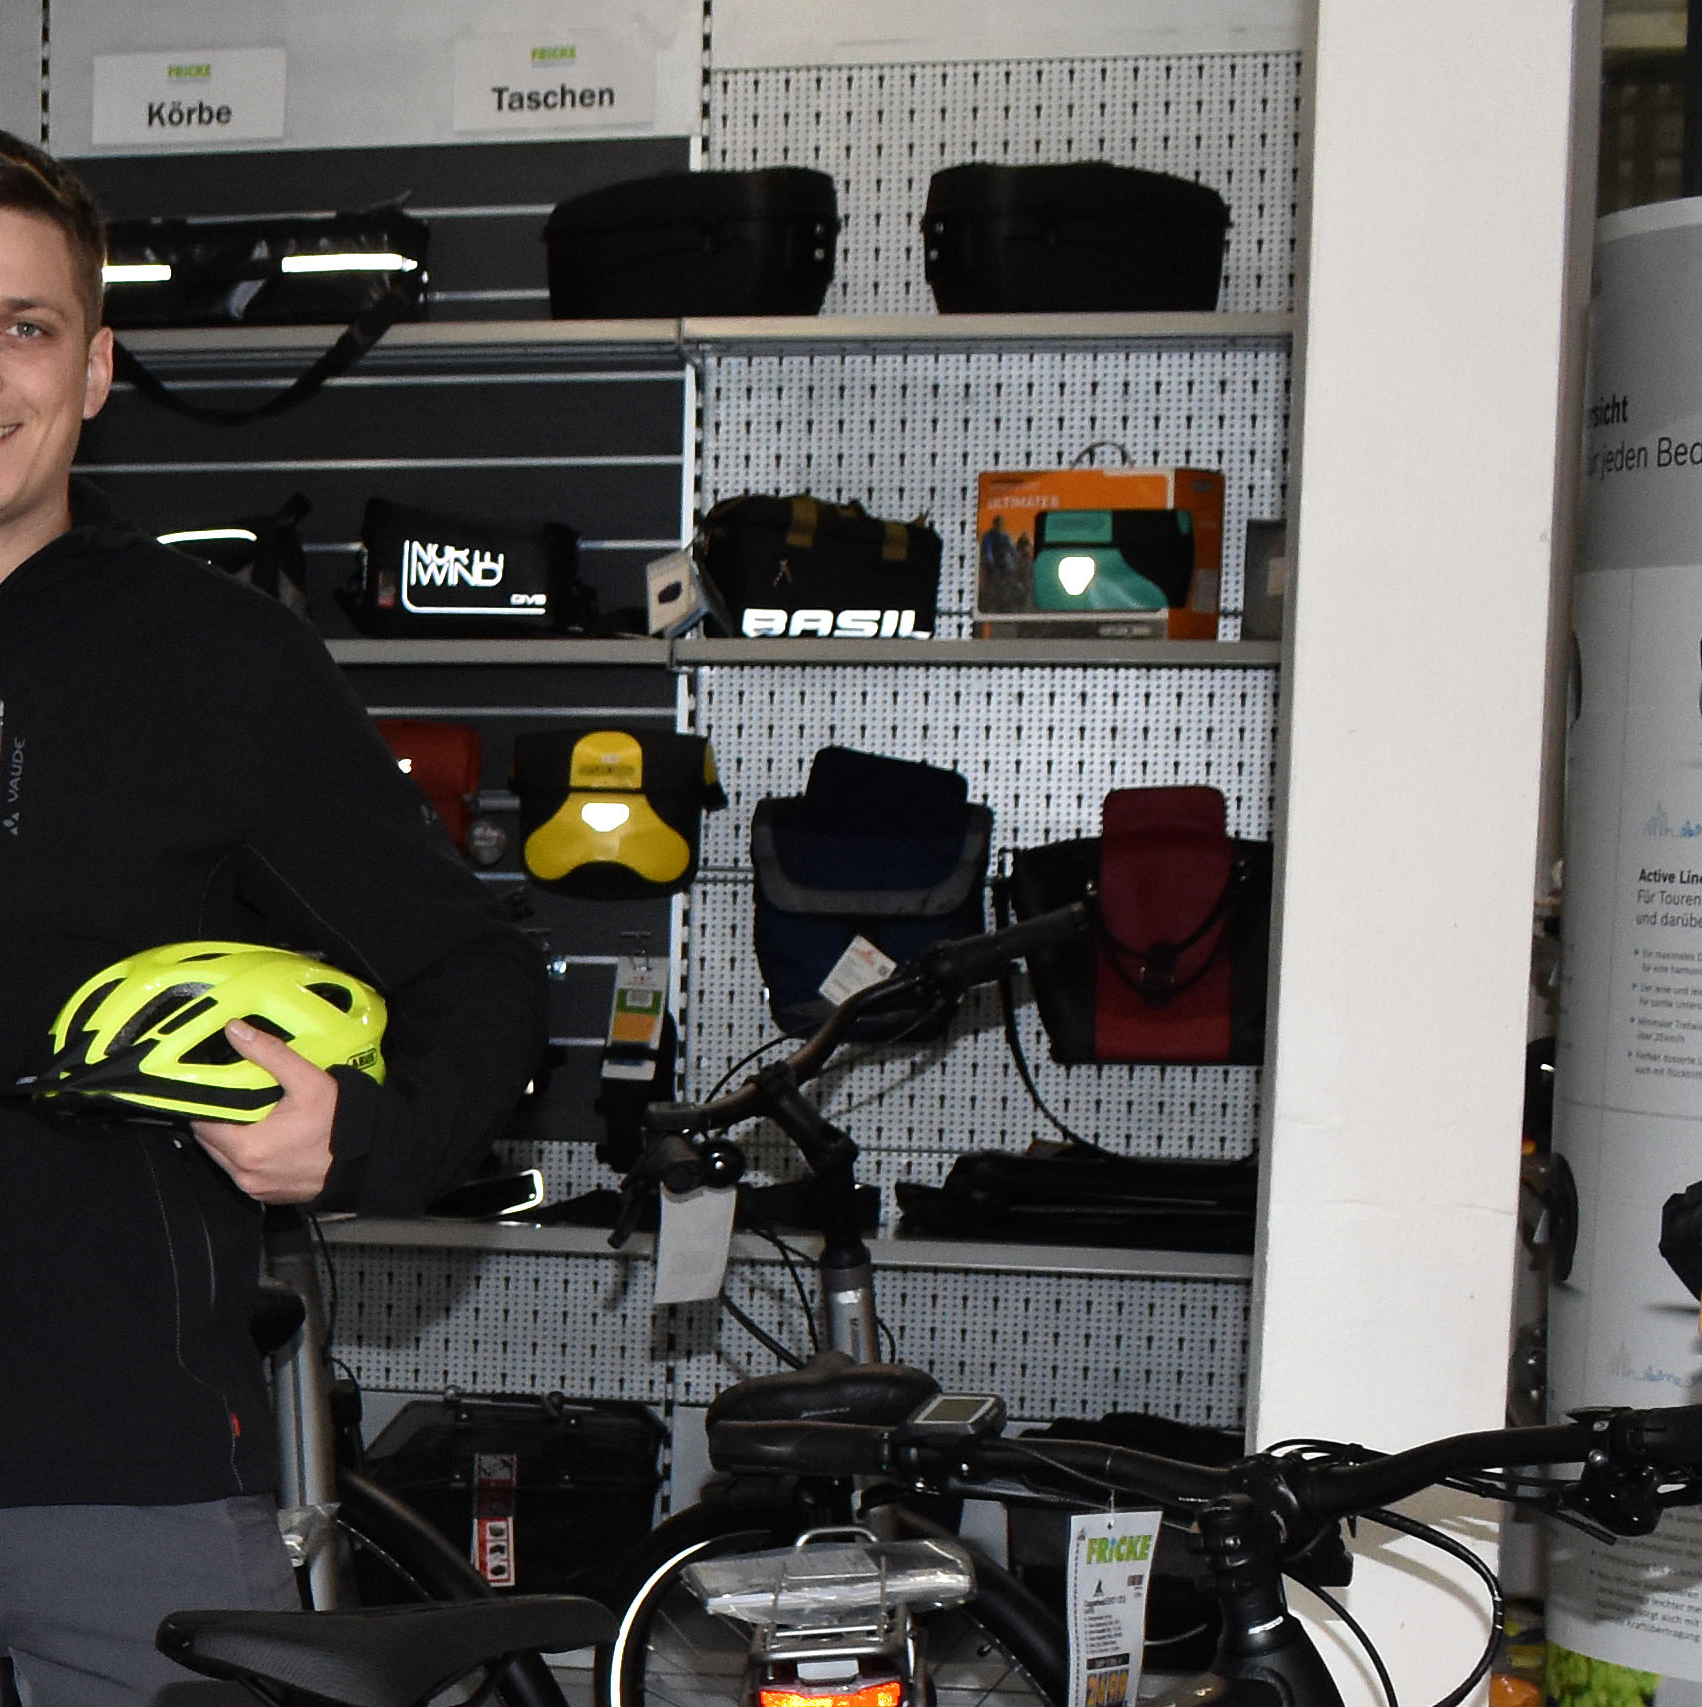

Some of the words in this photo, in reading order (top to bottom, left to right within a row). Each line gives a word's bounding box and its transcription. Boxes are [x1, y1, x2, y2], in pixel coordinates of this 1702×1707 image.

[491, 83, 615, 112] Taschen
[147, 102, 232, 127] Körbe
[741, 608, 933, 639] BASIL
[6, 736, 27, 803] VAUDE
[1638, 868, 1676, 885] Active
